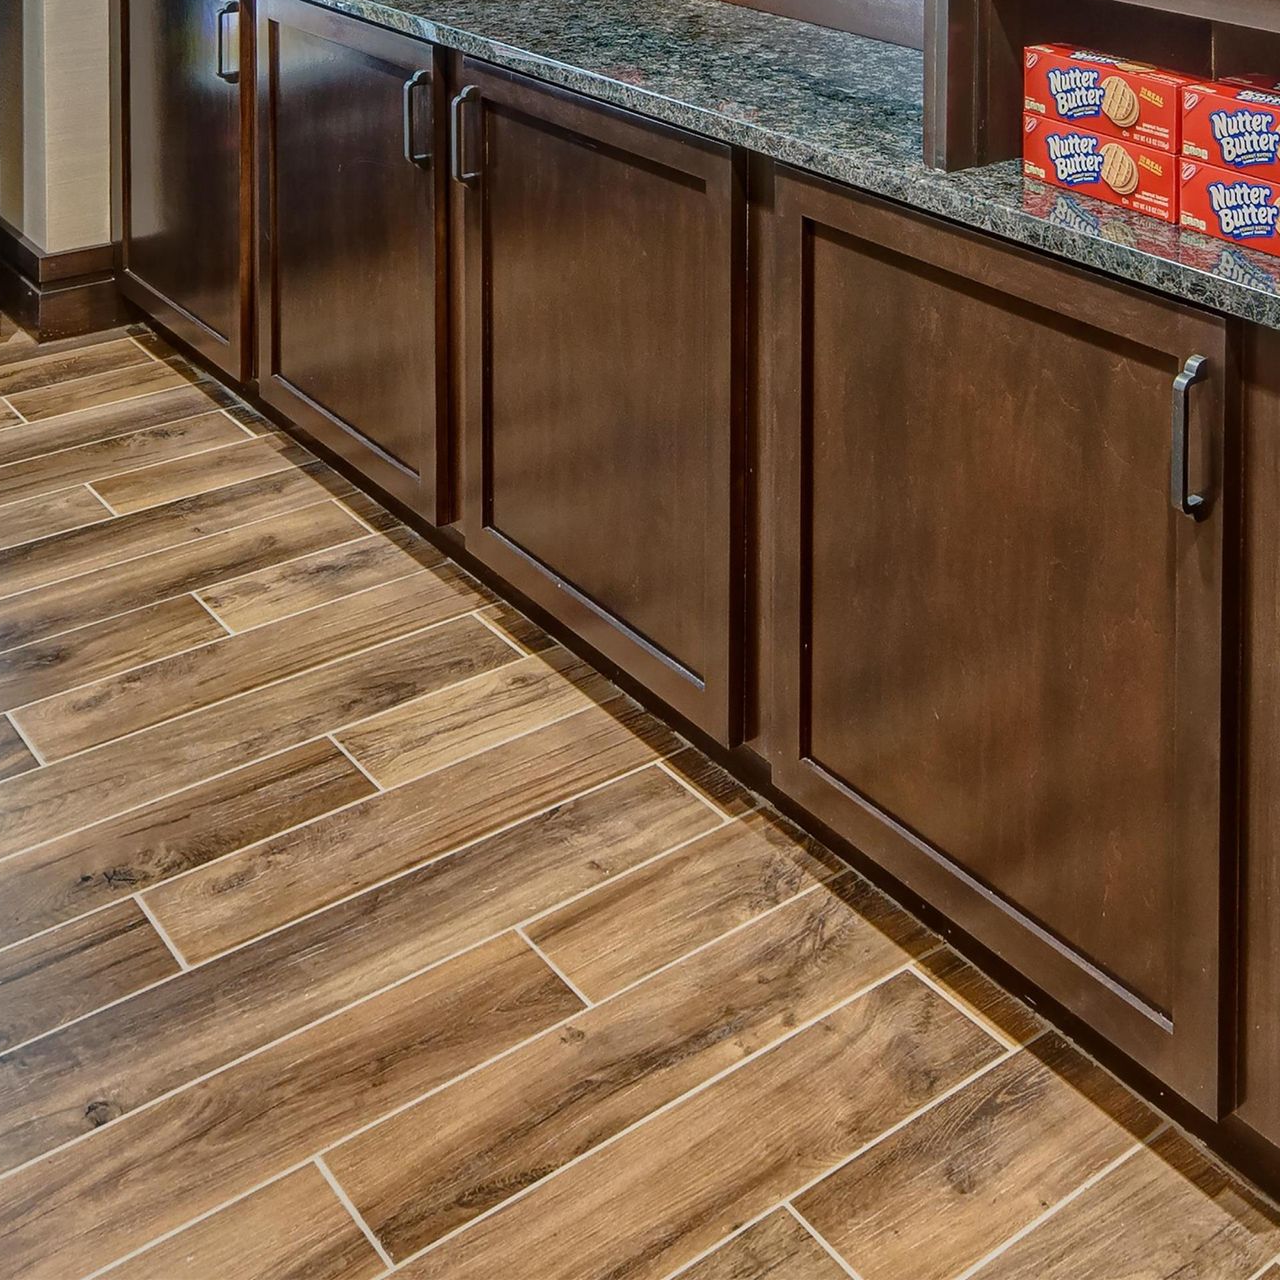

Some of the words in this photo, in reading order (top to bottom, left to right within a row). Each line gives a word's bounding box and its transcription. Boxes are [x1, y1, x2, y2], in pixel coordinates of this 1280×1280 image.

[1048, 69, 1097, 95] Nutter
[1055, 88, 1104, 115] Butter
[1146, 90, 1164, 104] REAL
[1211, 111, 1272, 139] Nutter
[1047, 134, 1097, 160] Nutter
[1220, 132, 1280, 162] Butter
[1054, 153, 1103, 180] Butter
[1145, 158, 1163, 172] REAL
[1209, 184, 1270, 212] Nutter
[1219, 204, 1278, 234] Butter
